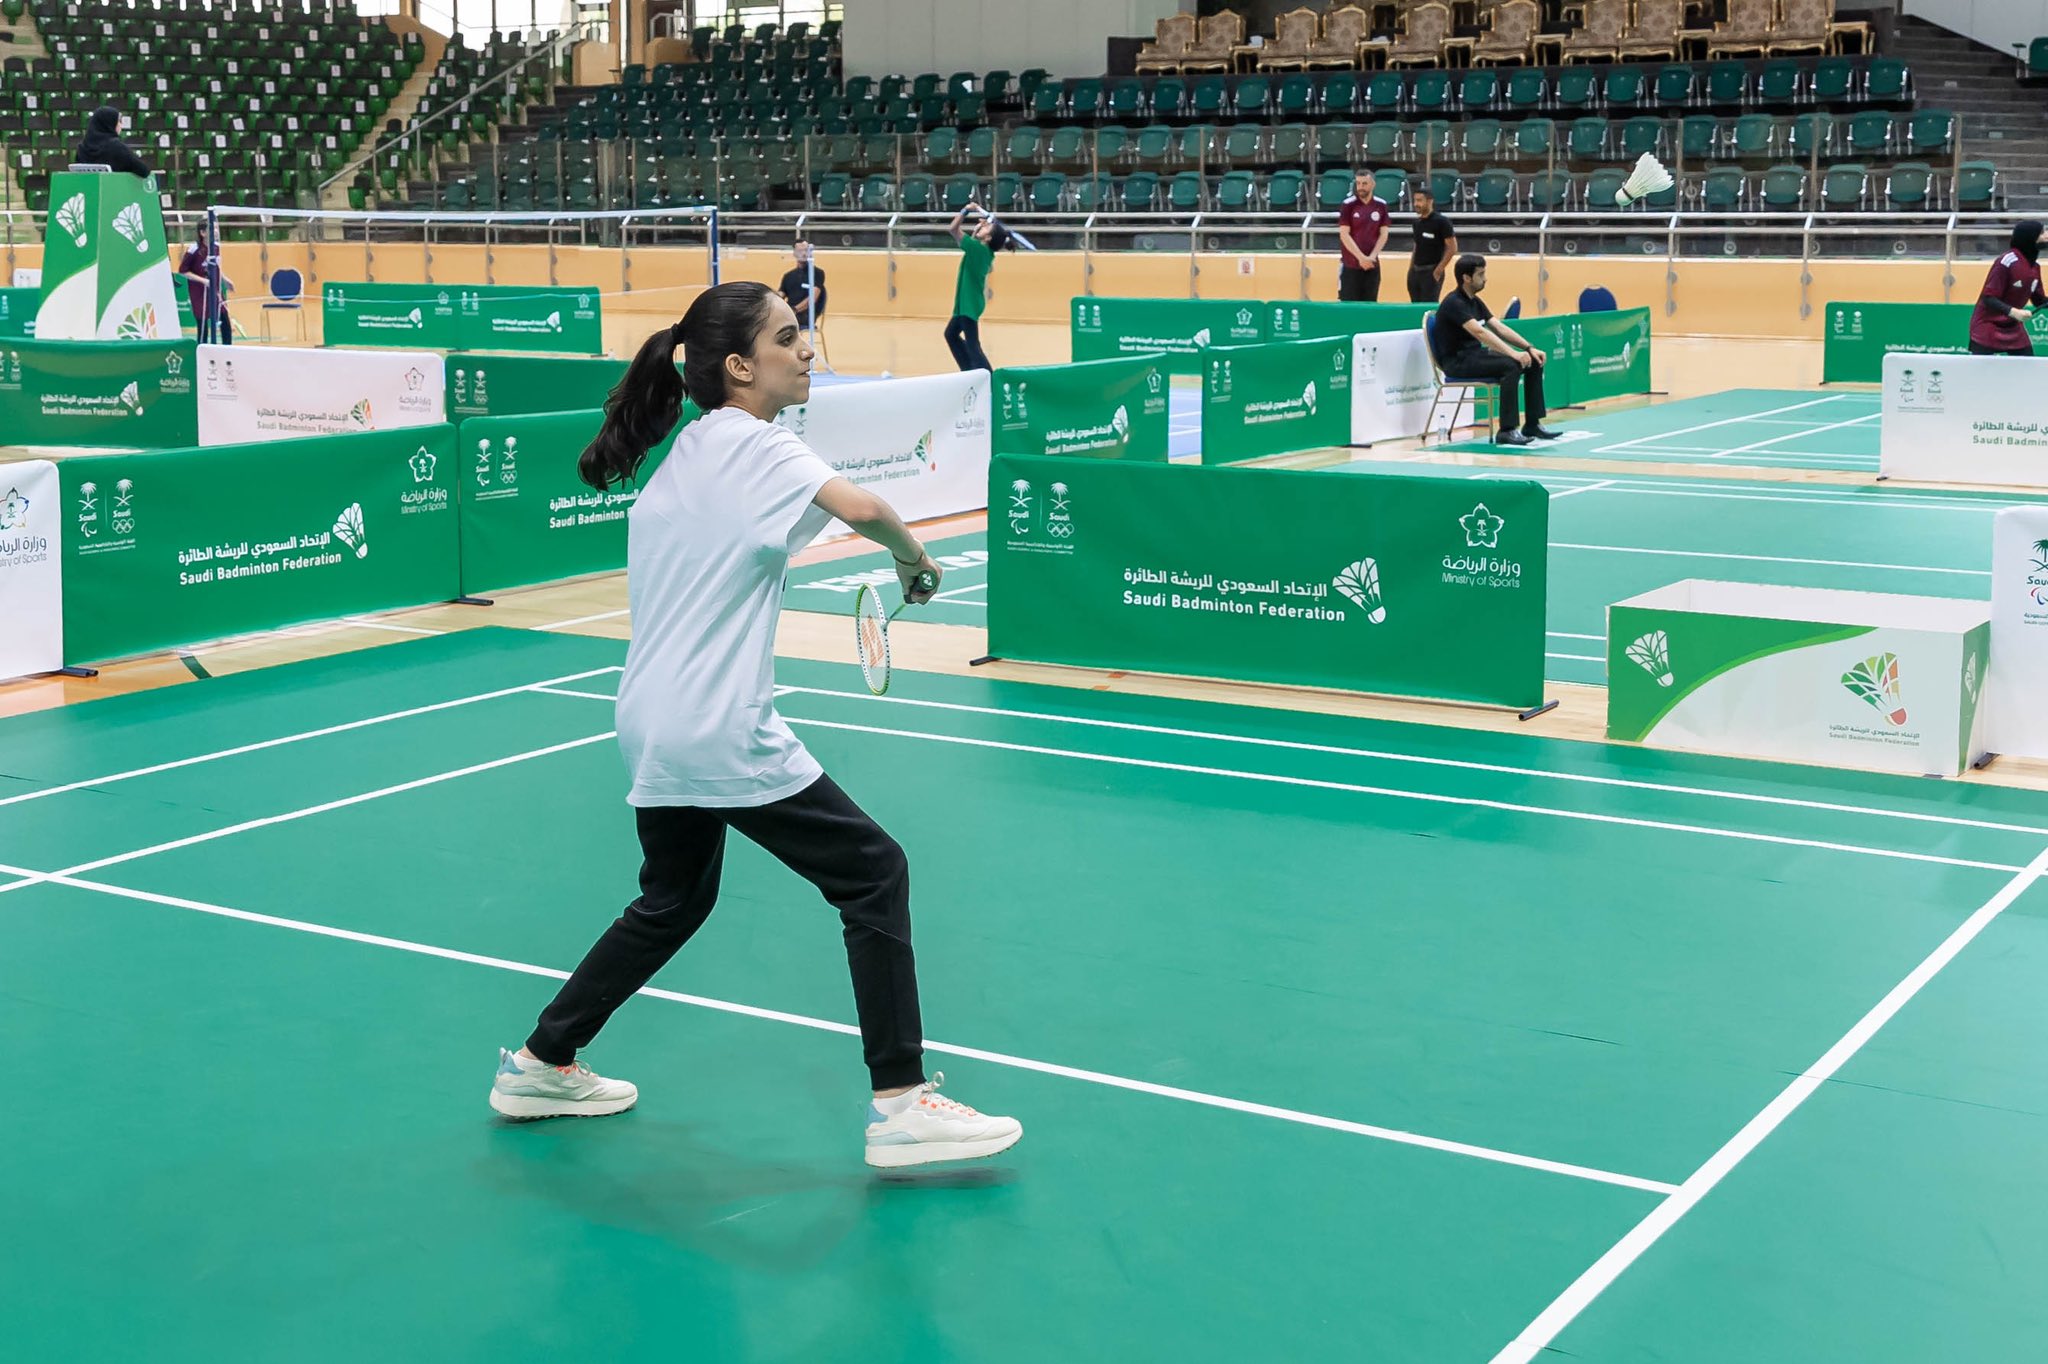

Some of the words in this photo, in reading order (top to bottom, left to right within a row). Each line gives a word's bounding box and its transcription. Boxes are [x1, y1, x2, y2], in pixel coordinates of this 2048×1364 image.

[1972, 435, 2003, 445] Saudi
[2006, 437, 2048, 446] Badmin
[400, 489, 428, 504] الرياضة
[428, 487, 447, 502] وزارة
[549, 514, 576, 528] Saudi
[577, 509, 625, 525] Badminton
[0, 537, 21, 556] الريا
[23, 535, 47, 553] وزارة
[251, 535, 298, 558] السعودي
[299, 531, 331, 549] الإتحاد
[22, 552, 47, 564] Sports
[178, 546, 213, 566] الطائرة
[215, 542, 249, 560] للريشة
[179, 568, 213, 586] Saudi
[217, 559, 279, 580] Badminton
[282, 552, 342, 571] Federation
[1442, 554, 1487, 575] الرياضة
[1489, 557, 1521, 578] وزارة
[1123, 567, 1167, 585] الطائرة
[1170, 570, 1213, 591] للريشة
[1441, 572, 1475, 587] Ministry
[1476, 575, 1487, 586] of
[1488, 575, 1521, 588] Sports
[2026, 575, 2048, 586] Sau
[1216, 579, 1280, 596] السعودي
[1283, 581, 1328, 602] الإتحاد
[1122, 590, 1166, 608] Saudi
[1171, 594, 1254, 614] Badminton
[1259, 602, 1346, 622] Federation
